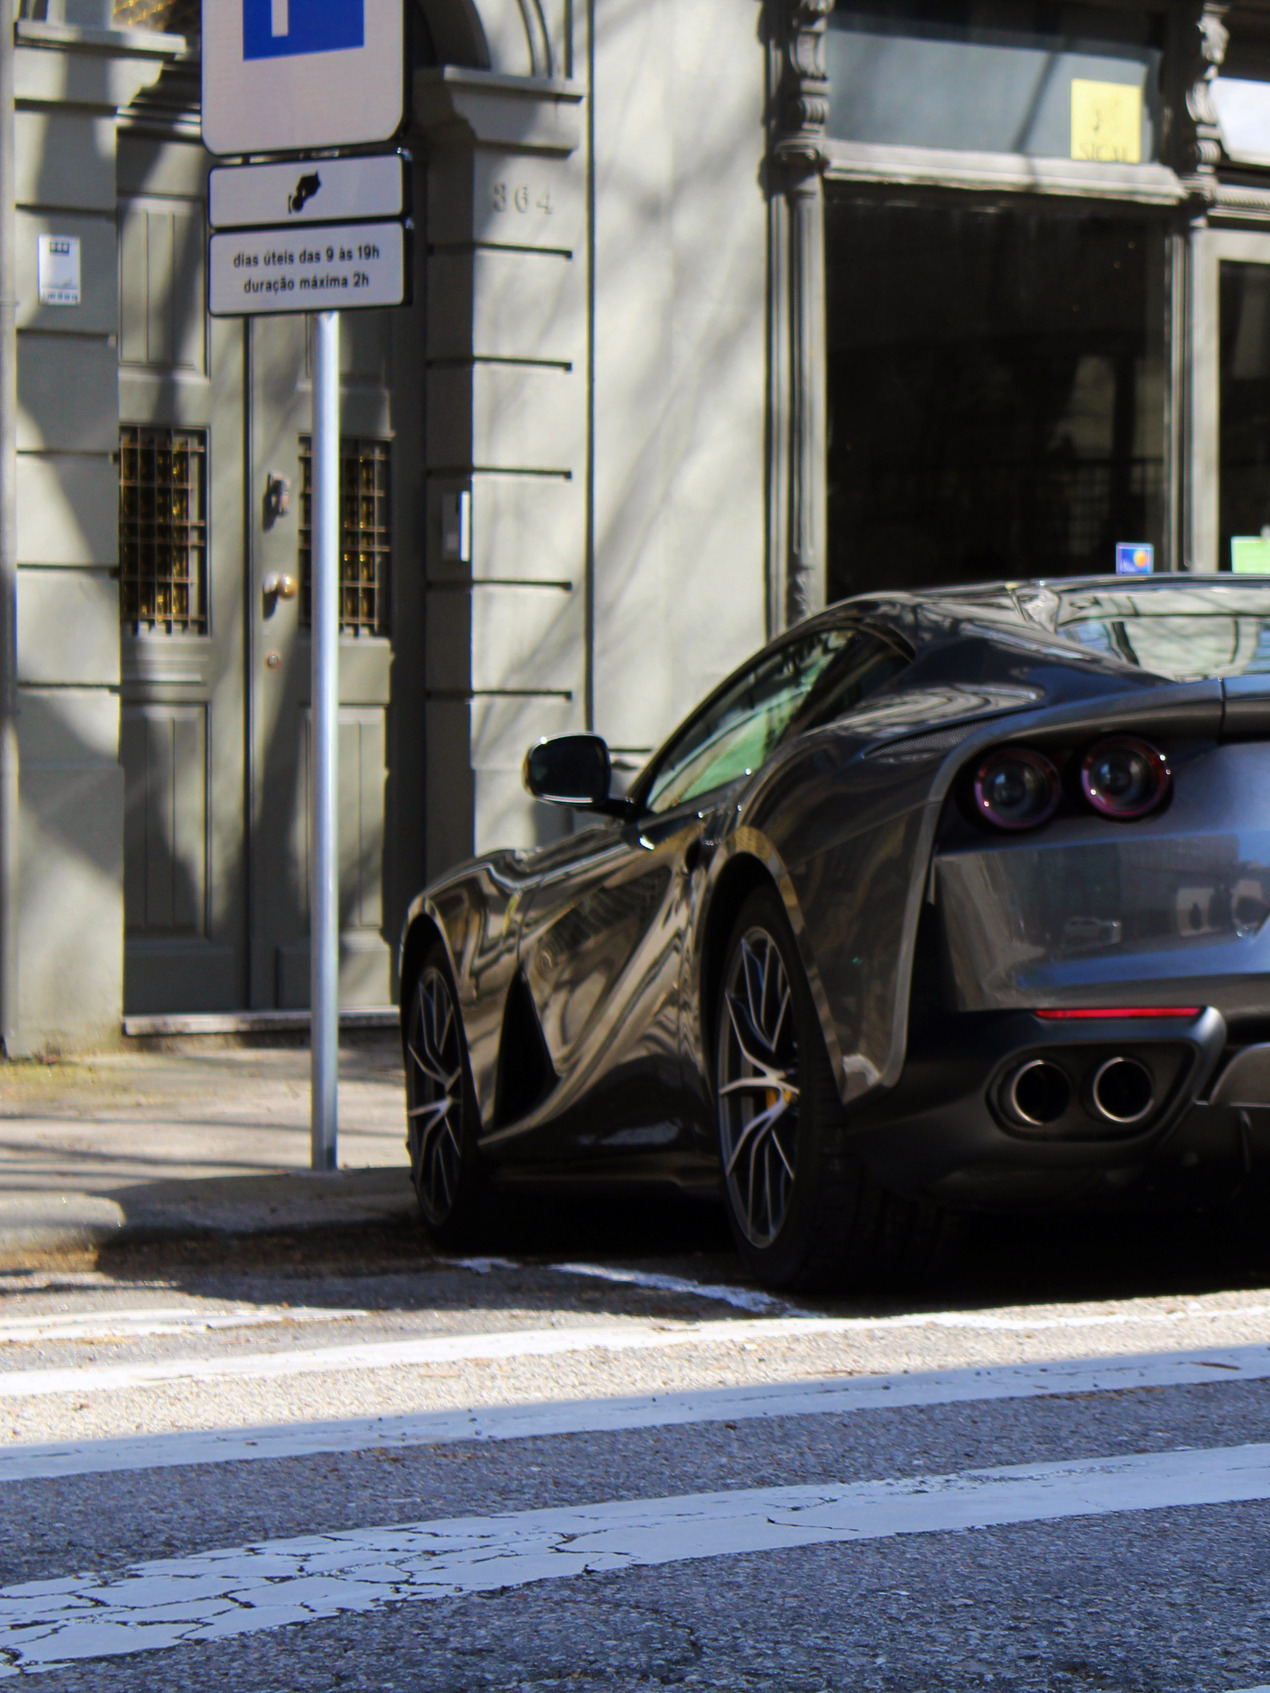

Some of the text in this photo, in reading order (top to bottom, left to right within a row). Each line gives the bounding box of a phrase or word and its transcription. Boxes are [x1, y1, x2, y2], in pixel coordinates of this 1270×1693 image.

[233, 244, 380, 268] dias úteis das 9 às 19h
[244, 271, 369, 295] duração máxima 2h
